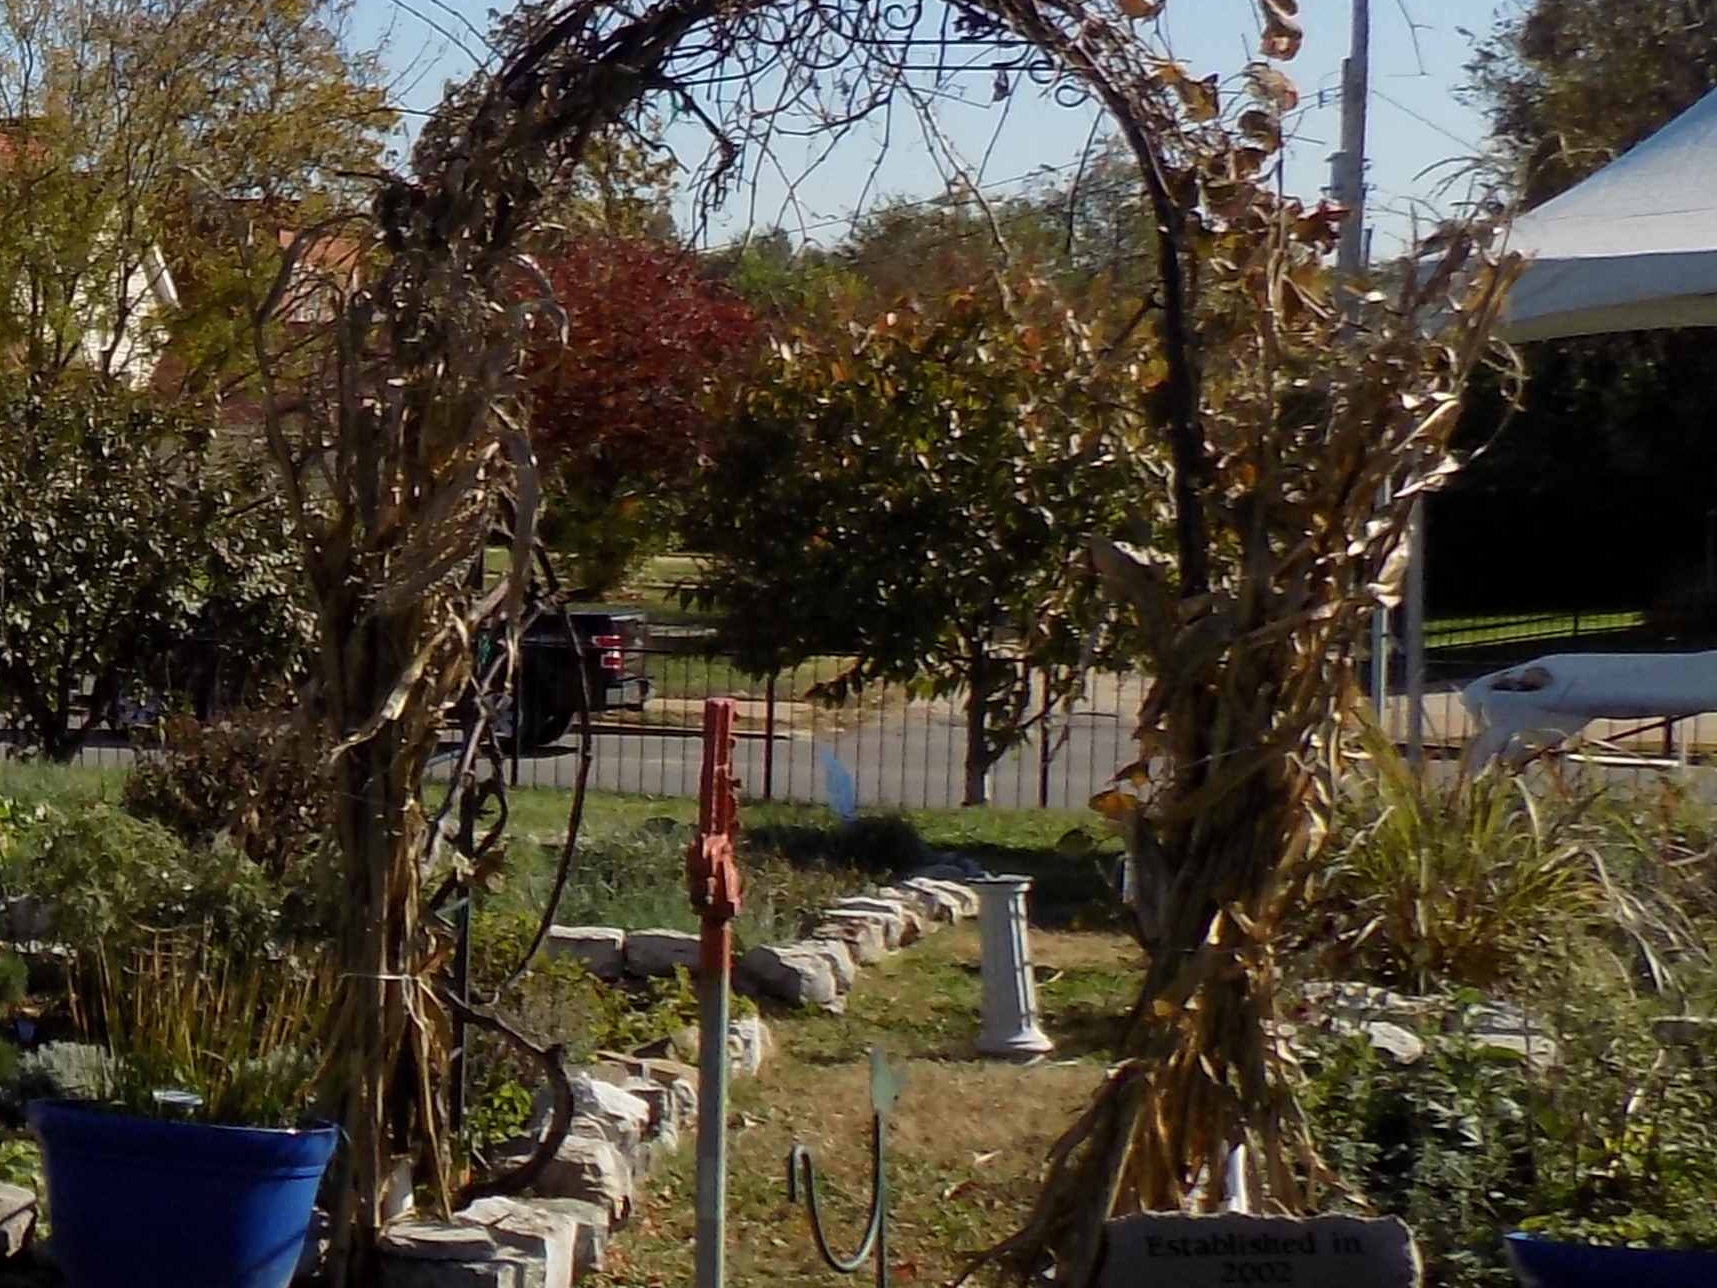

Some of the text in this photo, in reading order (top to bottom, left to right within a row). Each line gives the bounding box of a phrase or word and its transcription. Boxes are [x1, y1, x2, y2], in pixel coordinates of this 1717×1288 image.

[1146, 1231, 1363, 1257] Established in
[1221, 1261, 1292, 1284] 2002
